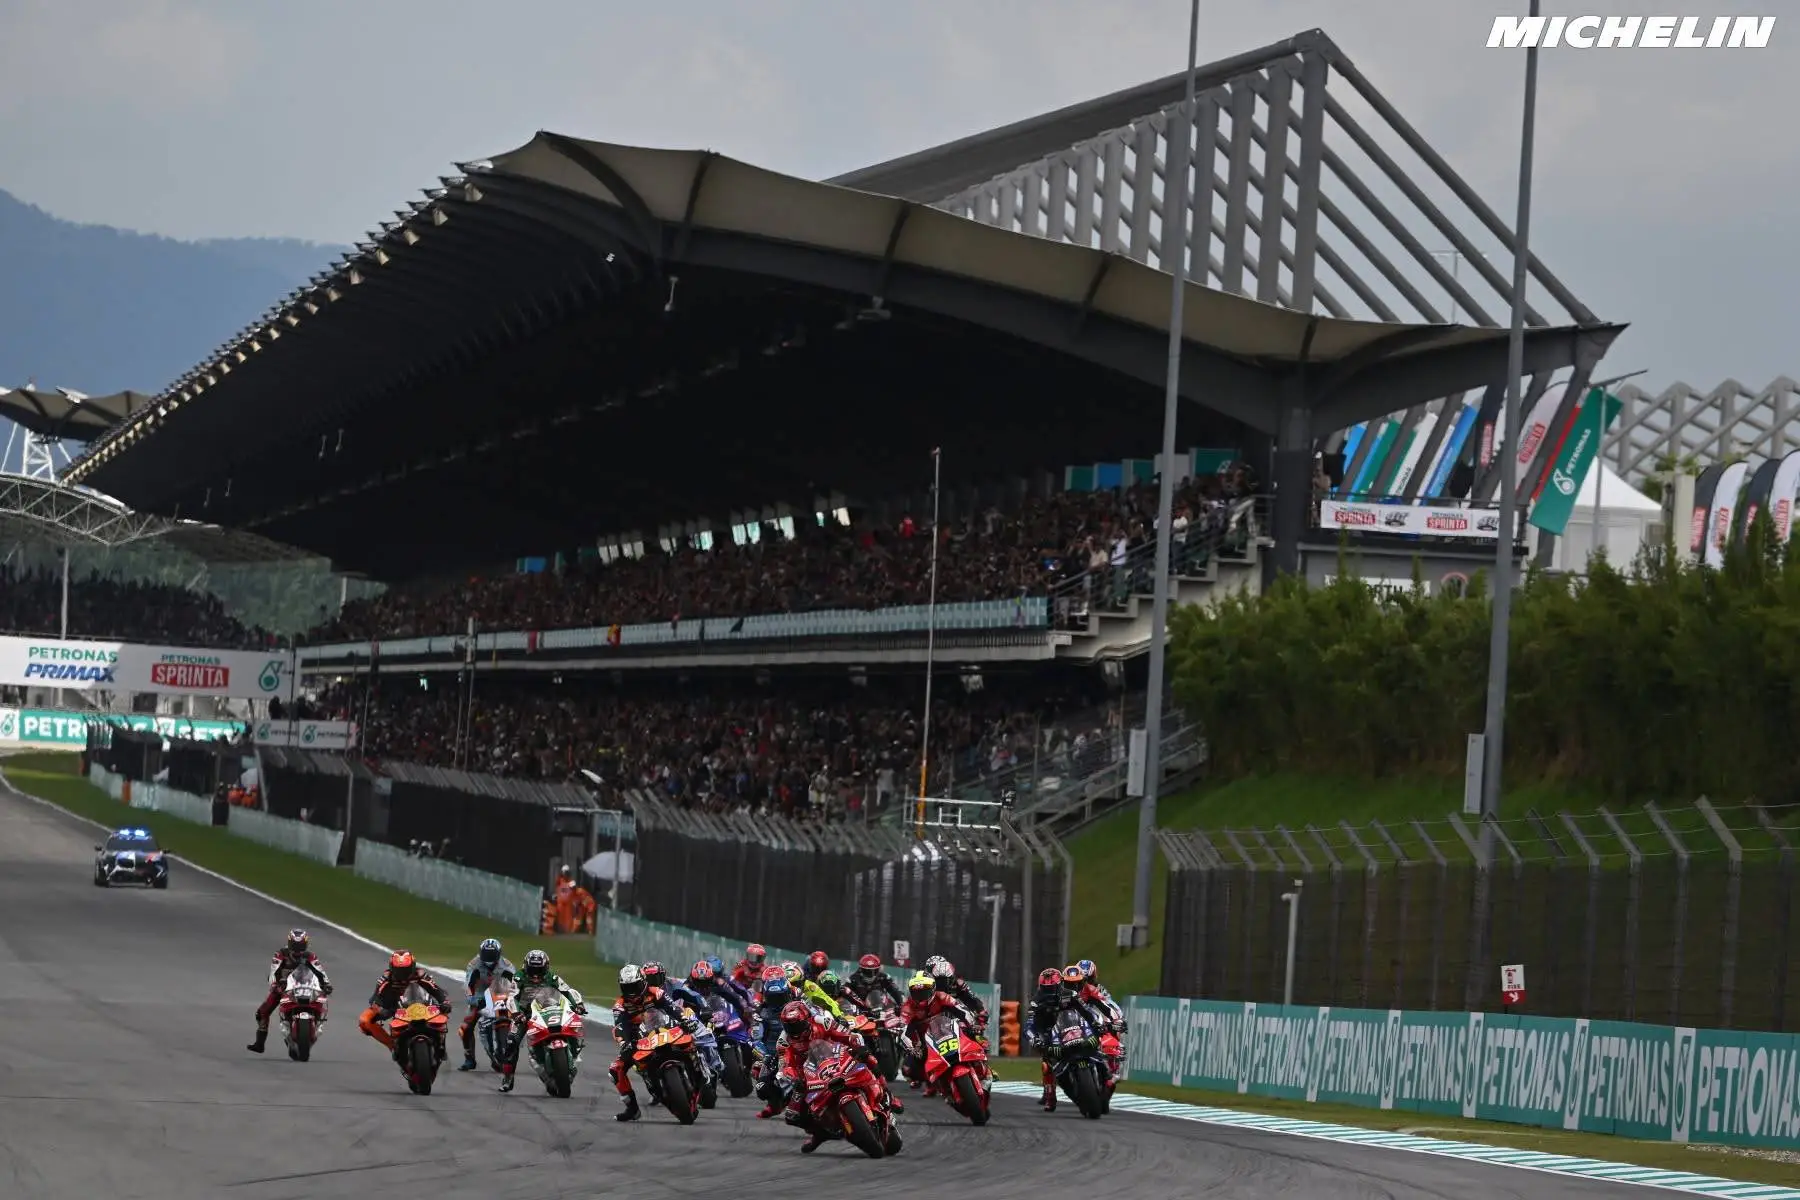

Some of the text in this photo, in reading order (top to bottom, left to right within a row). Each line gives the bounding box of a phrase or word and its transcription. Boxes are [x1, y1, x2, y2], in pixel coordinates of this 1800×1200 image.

[1565, 428, 1592, 475] PETRONAS
[1336, 511, 1375, 526] SPRINTA
[1429, 518, 1466, 531] SPRINTA
[28, 646, 118, 663] PETRONAS
[161, 654, 221, 665] PETRONAS
[24, 662, 115, 683] PRIMAX
[156, 664, 225, 687] SPRINTA
[649, 1032, 669, 1049] 37
[938, 1038, 960, 1057] 36
[1251, 1016, 1314, 1089] PETRONAS
[1320, 1020, 1386, 1096] PETRONAS
[1396, 1024, 1466, 1103] PETRONAS
[1480, 1027, 1569, 1112] PETRONAS
[1584, 1034, 1670, 1127] PETRONAS
